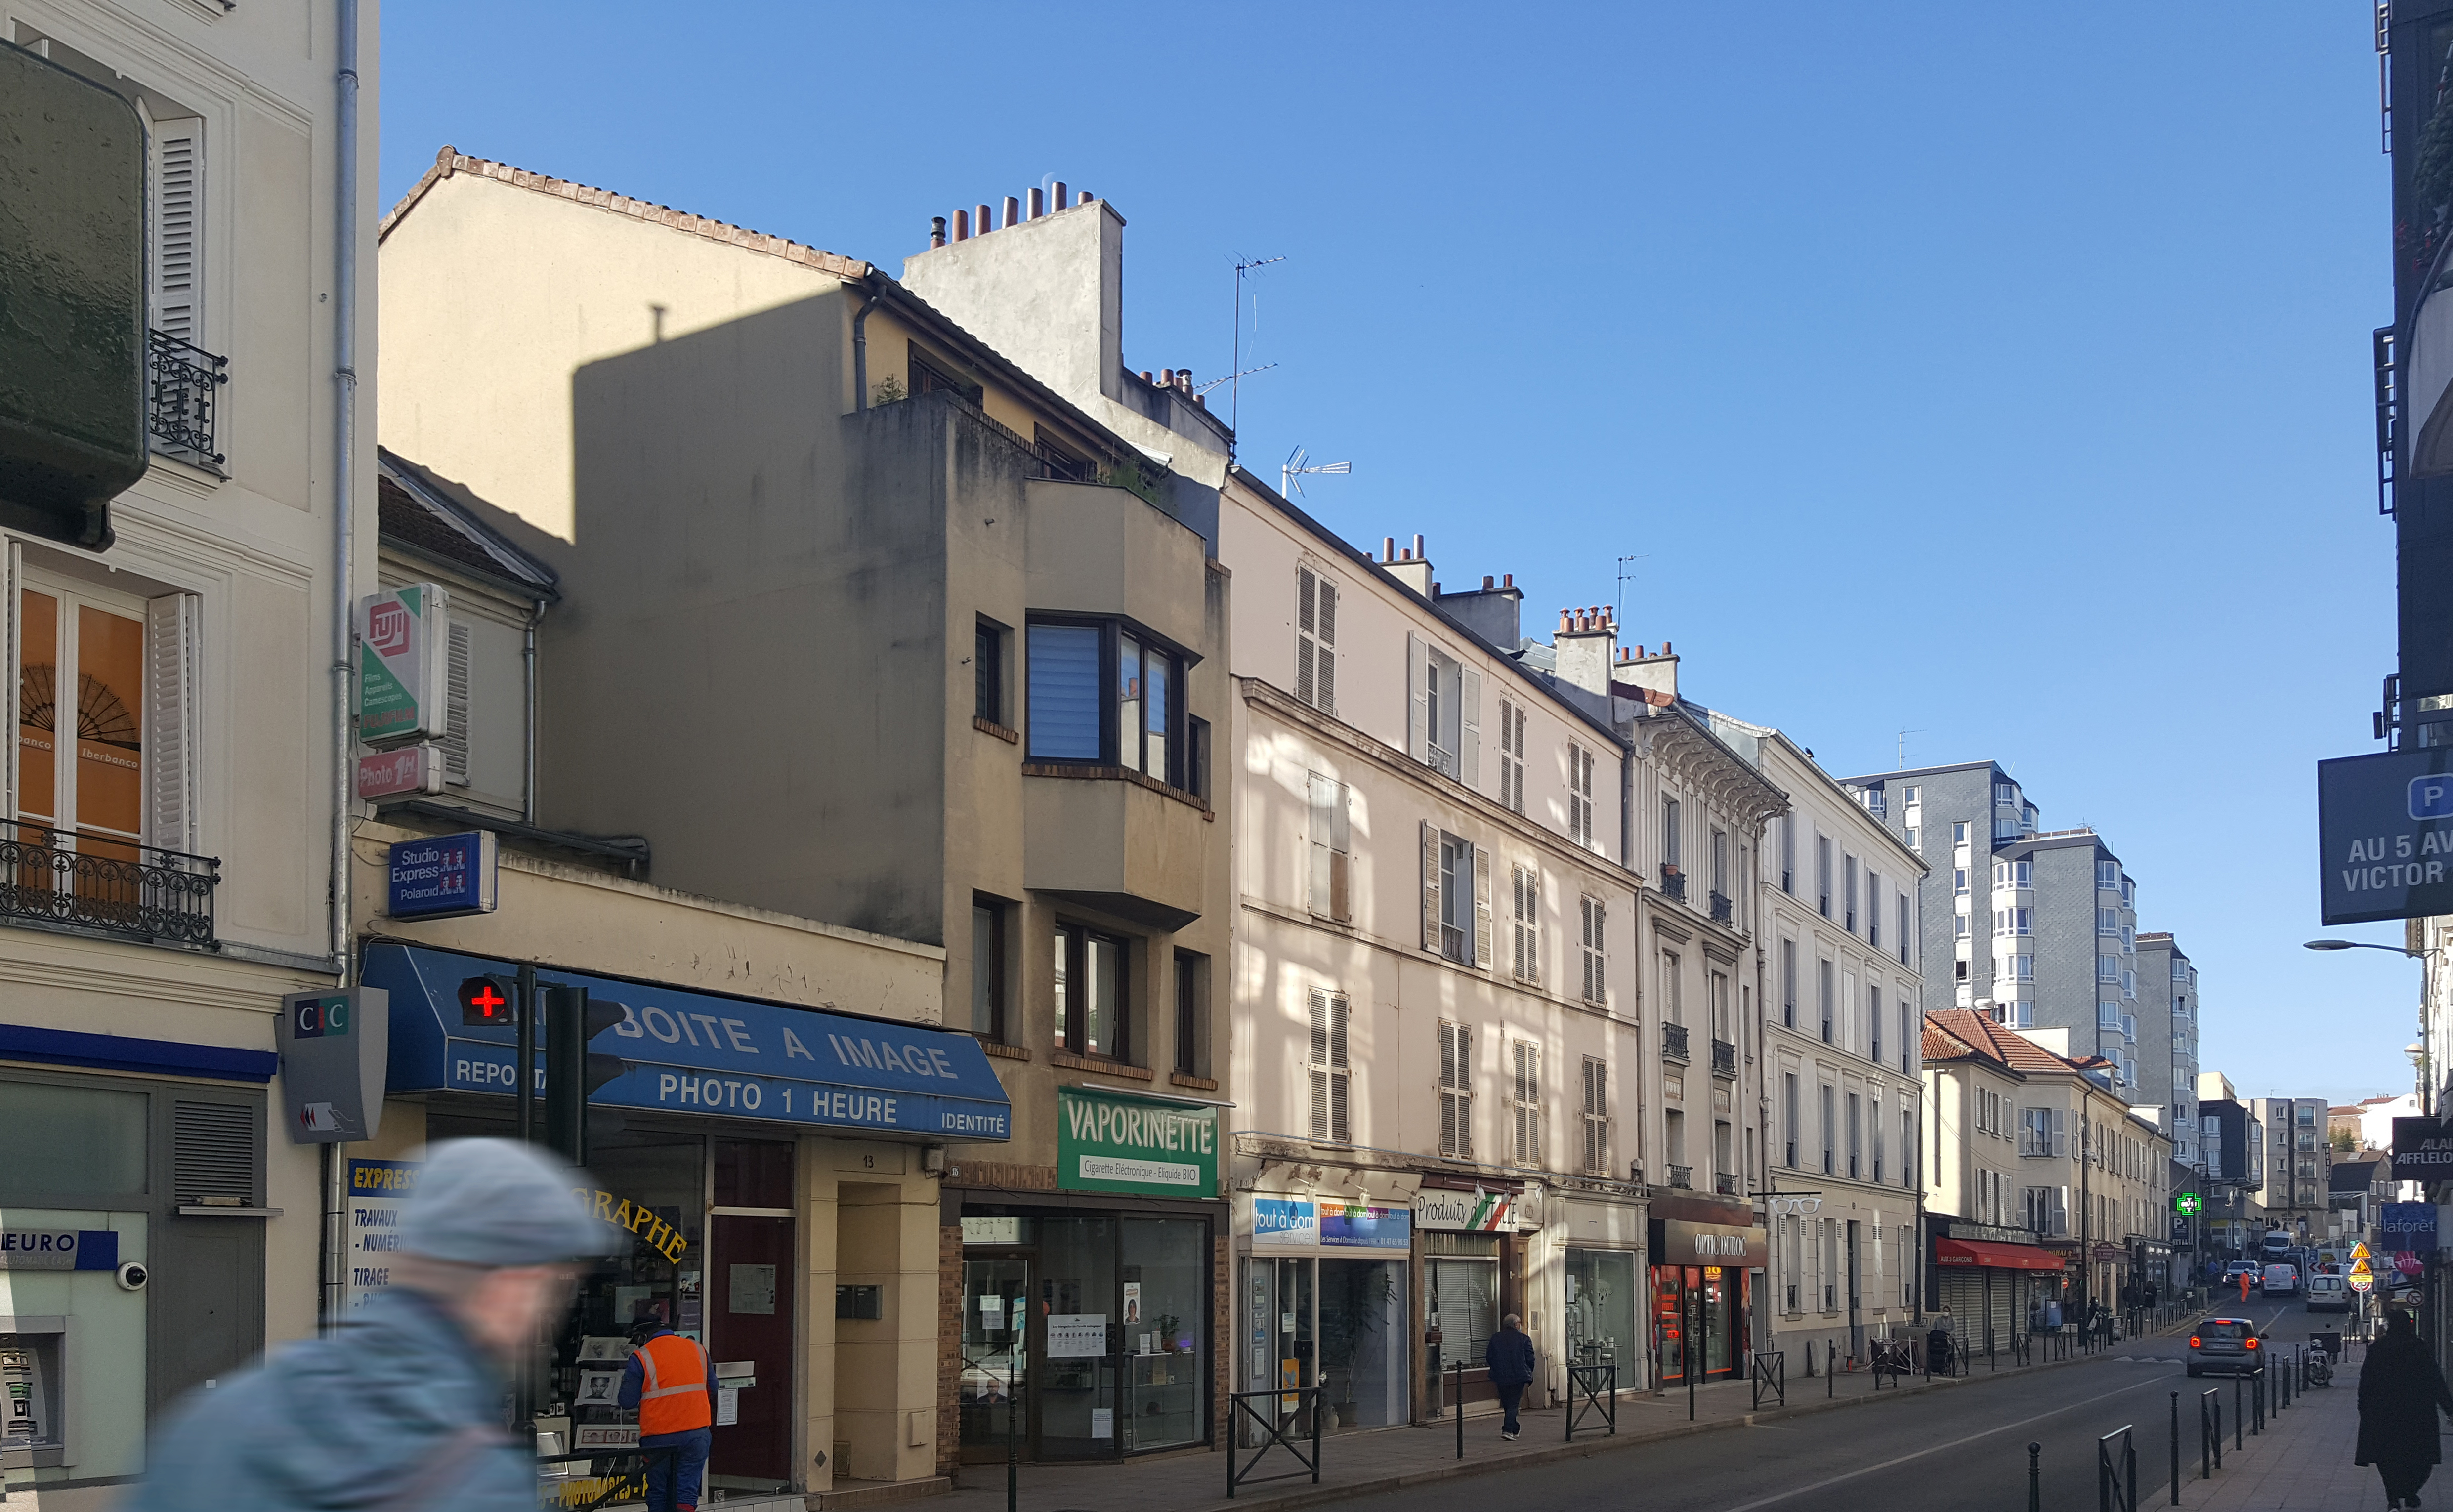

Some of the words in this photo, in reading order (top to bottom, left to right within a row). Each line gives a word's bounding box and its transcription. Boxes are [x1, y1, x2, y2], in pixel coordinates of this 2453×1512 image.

[365, 674, 381, 683] Films
[365, 681, 393, 695] Appareils
[363, 706, 415, 729] FUJIFILM
[82, 747, 138, 768] Iberbanco
[360, 765, 393, 787] Photo
[2425, 786, 2443, 807] P
[402, 847, 439, 865] Studio
[2348, 837, 2385, 863] AU
[2396, 835, 2411, 858] 5
[392, 866, 439, 883] Express
[2342, 861, 2444, 891] VICTOR
[401, 885, 439, 900] Polaroid
[299, 1004, 343, 1031] CIC
[613, 1002, 760, 1054] BOITE
[783, 1027, 815, 1061] A
[828, 1033, 959, 1080] IMAGE
[660, 1073, 761, 1110] PHOTO
[782, 1088, 791, 1113] 1
[813, 1091, 897, 1123] HEURE
[942, 1111, 1005, 1133] IDENTITÉ
[1066, 1099, 1212, 1155] VAPORINETTE
[2420, 1138, 2453, 1150] ALAI
[863, 1154, 874, 1168] 13
[1085, 1160, 1113, 1176] Cigarette
[1115, 1163, 1152, 1180] Eléctronique
[1158, 1167, 1181, 1181] Eliquide
[1183, 1169, 1196, 1181] BIO
[354, 1167, 420, 1190] EXPRESS
[952, 1168, 959, 1176] 15
[355, 1209, 398, 1227] TRAVAUX
[1255, 1207, 1276, 1227] tout
[1279, 1209, 1286, 1228] à
[1290, 1210, 1314, 1229] dom
[1330, 1207, 1333, 1216] à
[1334, 1208, 1344, 1216] dom
[1417, 1194, 1467, 1224] Produits
[2174, 1218, 2183, 1229] P
[2384, 1218, 2435, 1232] laforêt
[1279, 1232, 1314, 1245] services
[1695, 1233, 1719, 1255] OPTIC
[1720, 1236, 1746, 1257] DUROC
[354, 1268, 389, 1287] TIRAGE
